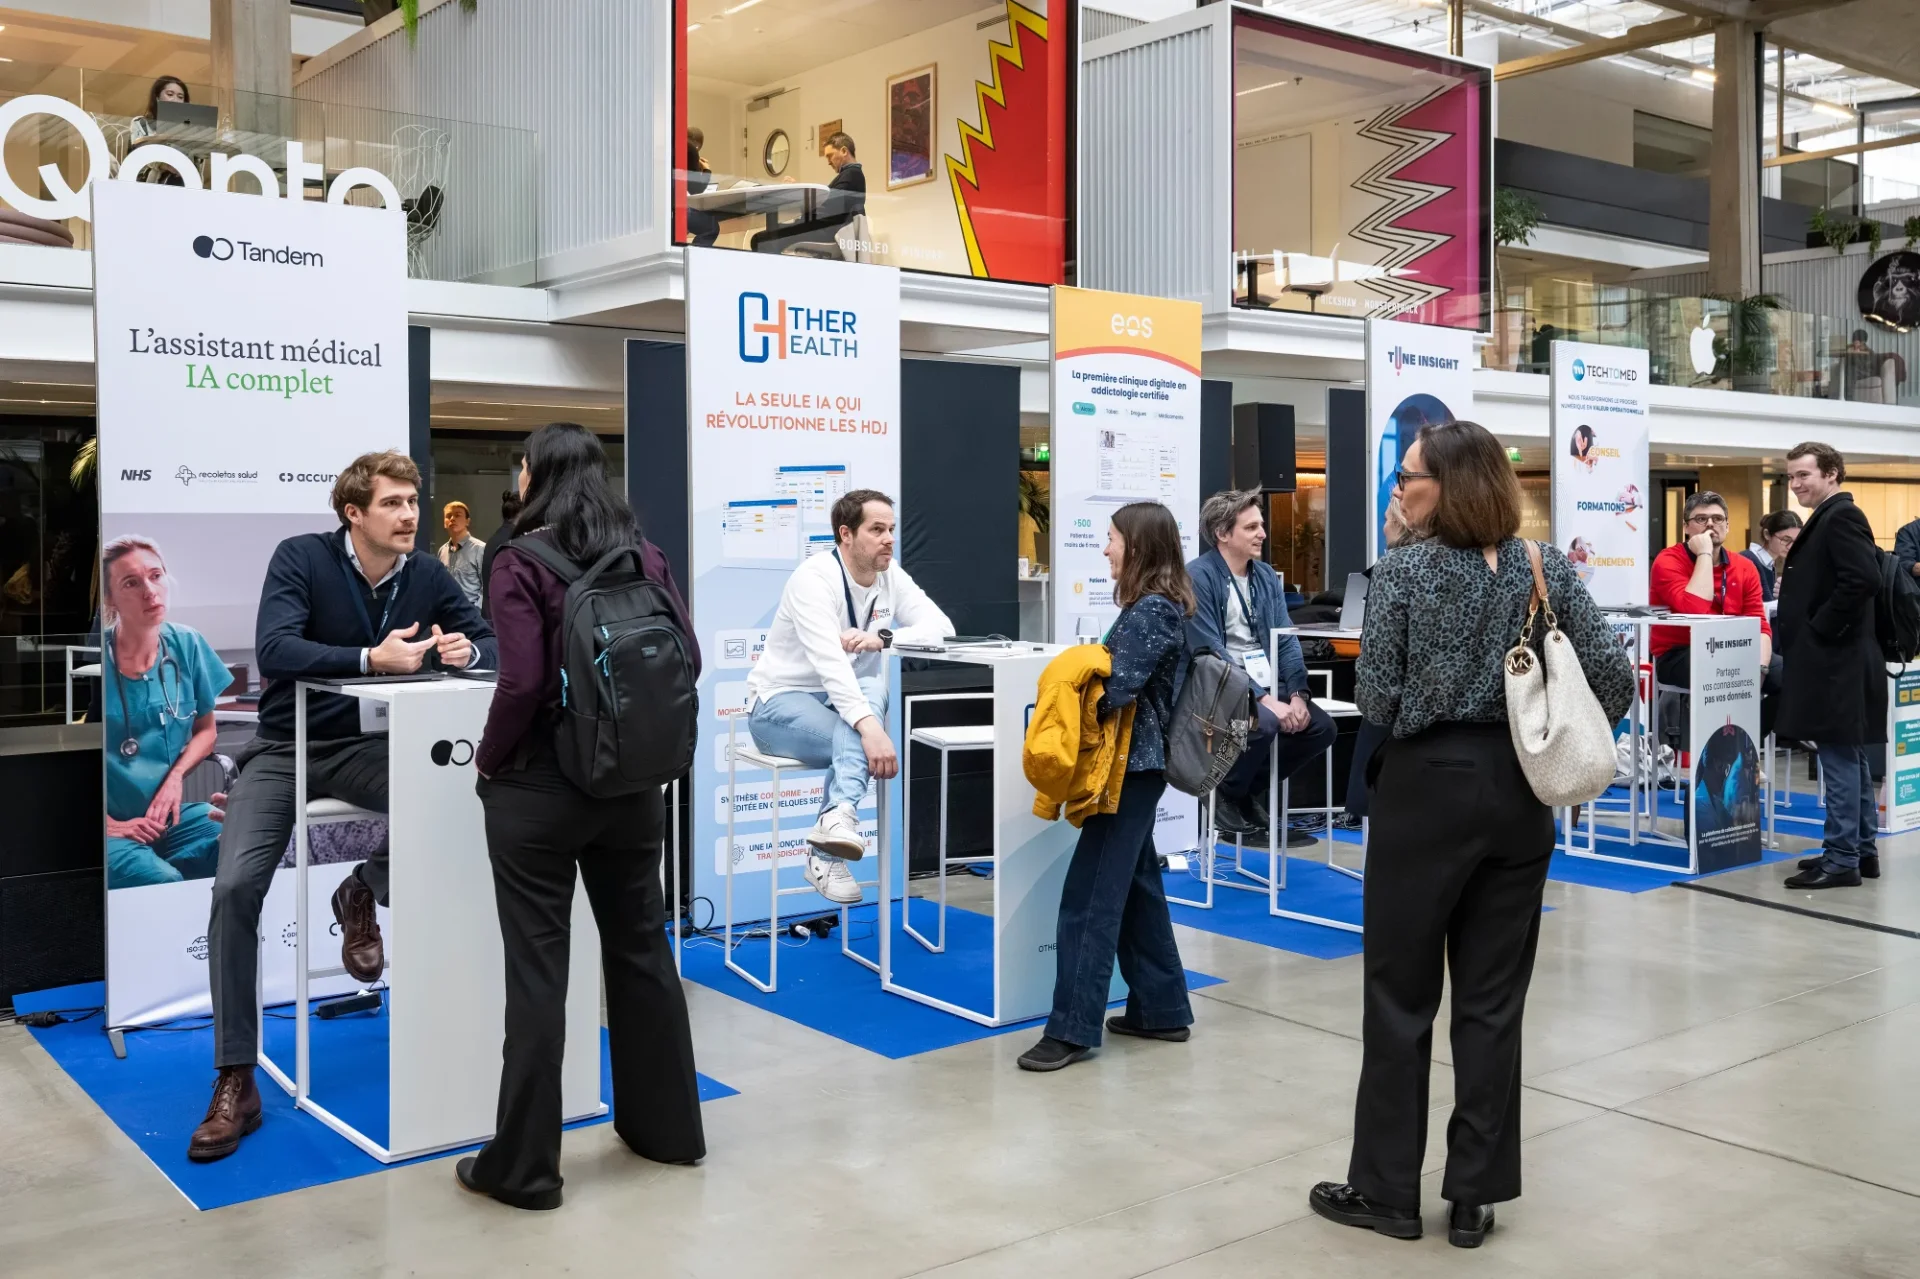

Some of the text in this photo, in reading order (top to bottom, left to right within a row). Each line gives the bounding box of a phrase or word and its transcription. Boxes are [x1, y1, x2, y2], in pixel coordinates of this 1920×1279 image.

[839, 238, 889, 255] BOBSLED
[237, 240, 324, 267] Tandem
[1320, 295, 1356, 307] RICKSHAW
[1111, 313, 1153, 338] eos
[281, 339, 382, 367] médical
[1418, 355, 1459, 370] INSIGHT
[1586, 365, 1638, 381] TECHTOMED
[186, 365, 333, 399] IA complet
[1072, 370, 1187, 390] La première clinique digitale en
[1091, 386, 1169, 401] addictologie certifiée
[735, 391, 861, 413] LA SEULE IA QUI
[706, 411, 888, 435] RÉVOLUTIONNE LES HDJ
[1590, 447, 1620, 457] CONSEIL
[121, 469, 152, 481] NHS
[198, 471, 236, 479] recoletas
[238, 471, 258, 479] salud
[1577, 501, 1625, 512] FORMATIONS
[1611, 623, 1635, 632] SIGHT
[1725, 638, 1752, 649] INSIGHT
[1715, 667, 1740, 678] Partagez
[1702, 683, 1713, 691] vos
[1704, 695, 1715, 706] pas
[1716, 694, 1726, 702] vos
[720, 792, 758, 804] SYTHÈSE
[760, 789, 801, 800] COORME
[758, 802, 768, 810] EN
[749, 843, 765, 851] UNE
[756, 848, 808, 860] TRASDISCIPL
[1038, 942, 1057, 953] OTHE
